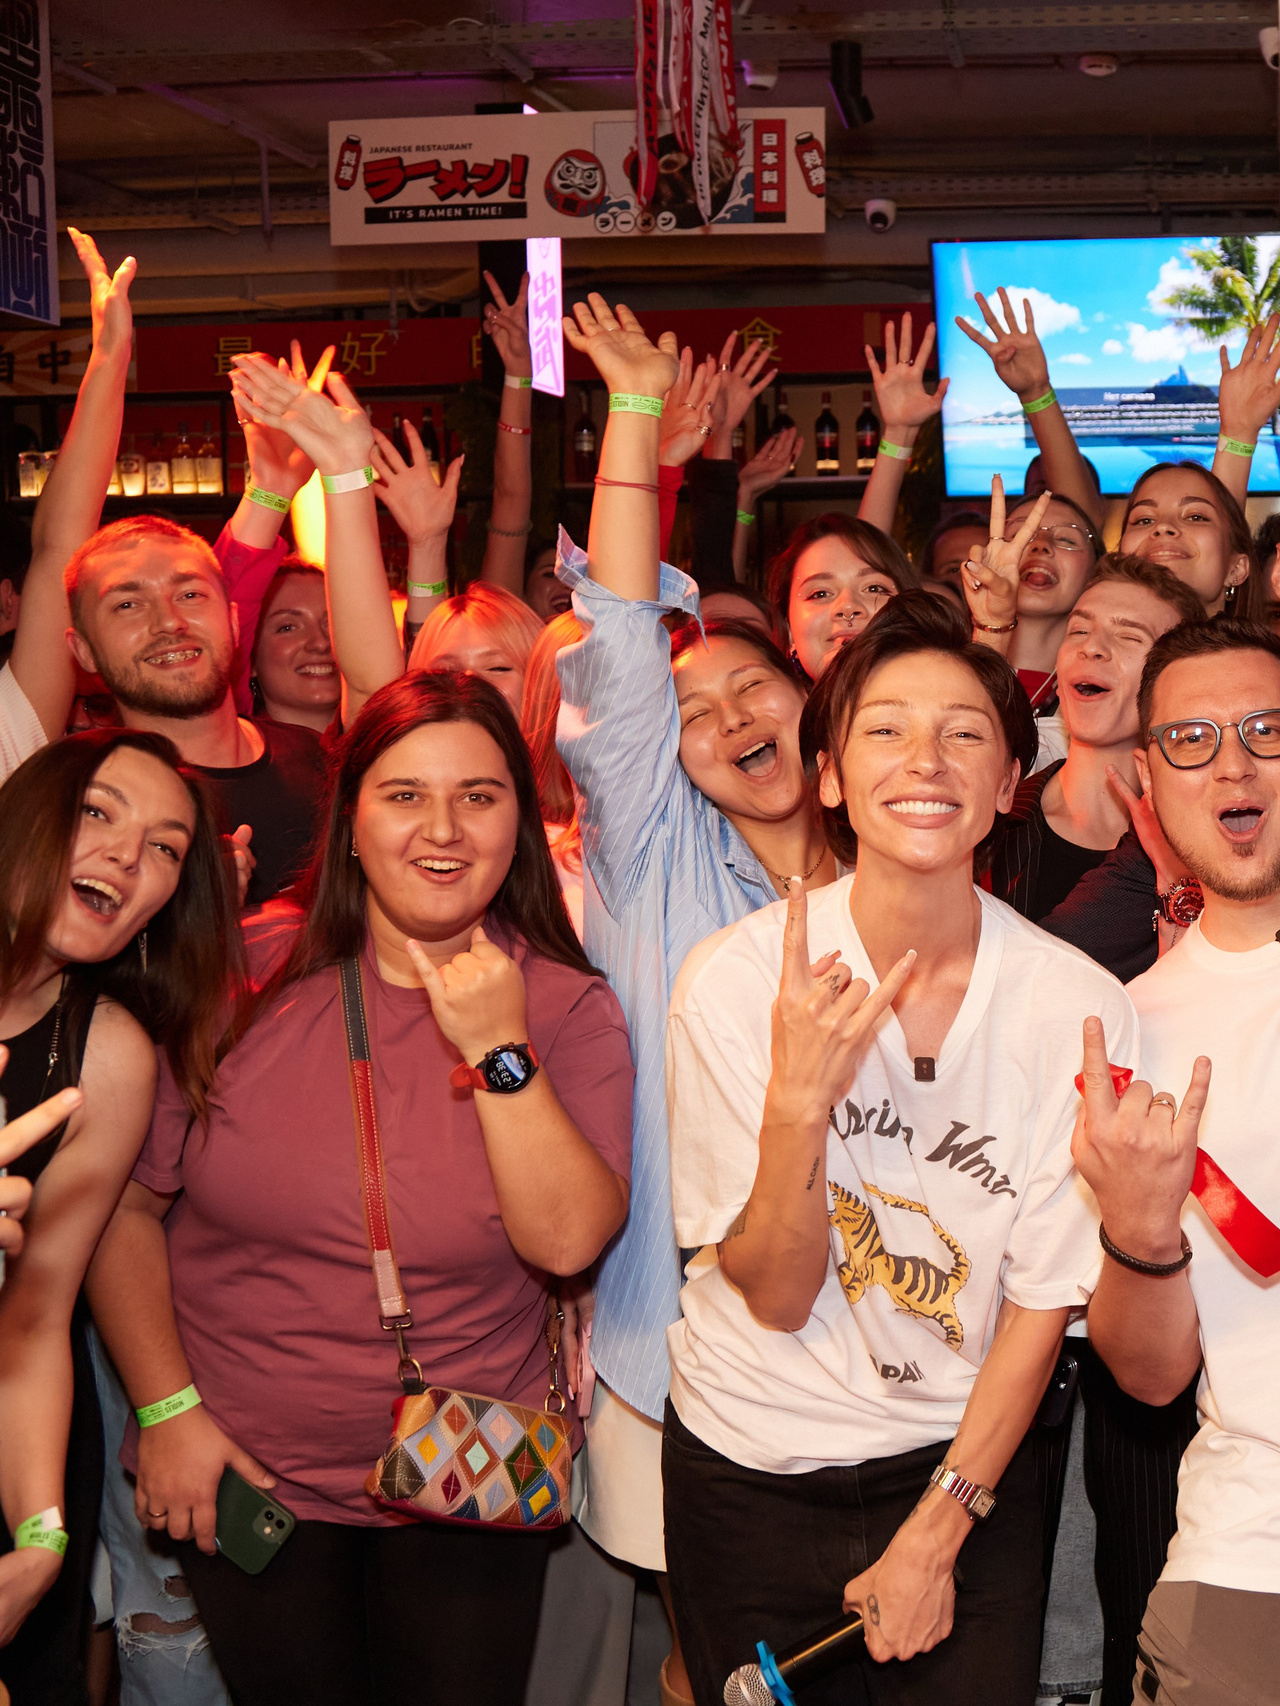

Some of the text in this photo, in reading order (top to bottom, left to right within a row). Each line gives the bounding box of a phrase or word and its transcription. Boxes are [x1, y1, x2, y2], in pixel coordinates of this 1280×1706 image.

[699, 6, 714, 40] МЫ
[369, 142, 473, 154] JAPANESE RESTAURANT
[761, 132, 778, 204] 日本料理
[388, 206, 503, 219] IT'S RAMEN TIME!
